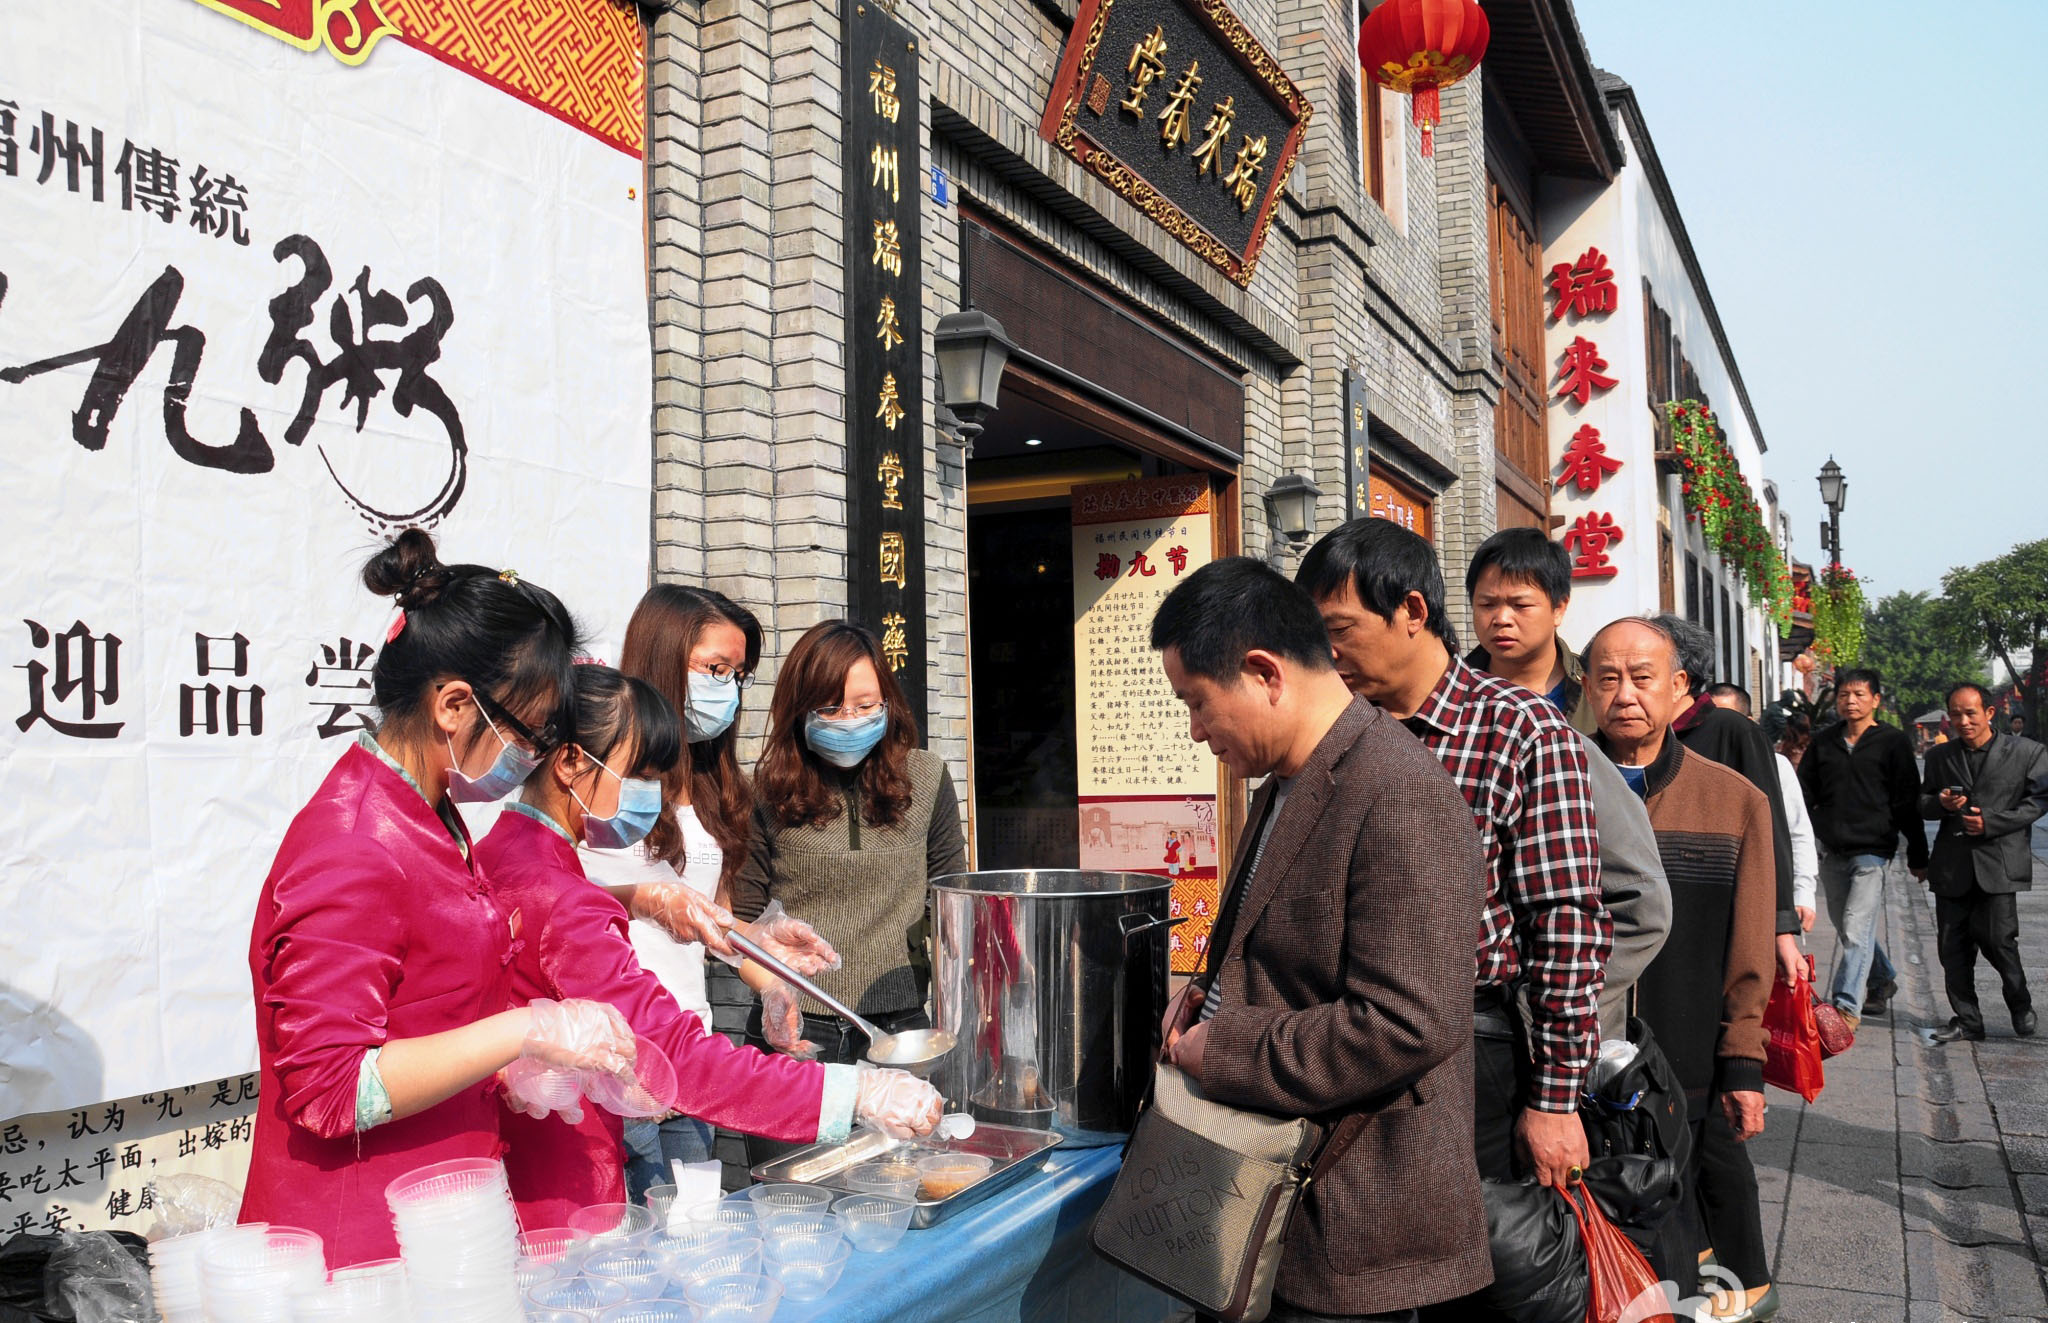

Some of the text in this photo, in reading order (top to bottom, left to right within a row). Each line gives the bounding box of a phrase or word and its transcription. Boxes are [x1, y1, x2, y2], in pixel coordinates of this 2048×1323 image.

[1094, 545, 1189, 580] 拗九节
[1131, 1154, 1201, 1200] LOUIS
[0, 1186, 153, 1237] 平安、健康
[1117, 1177, 1246, 1241] VUITTON
[1165, 1225, 1217, 1257] PARIS
